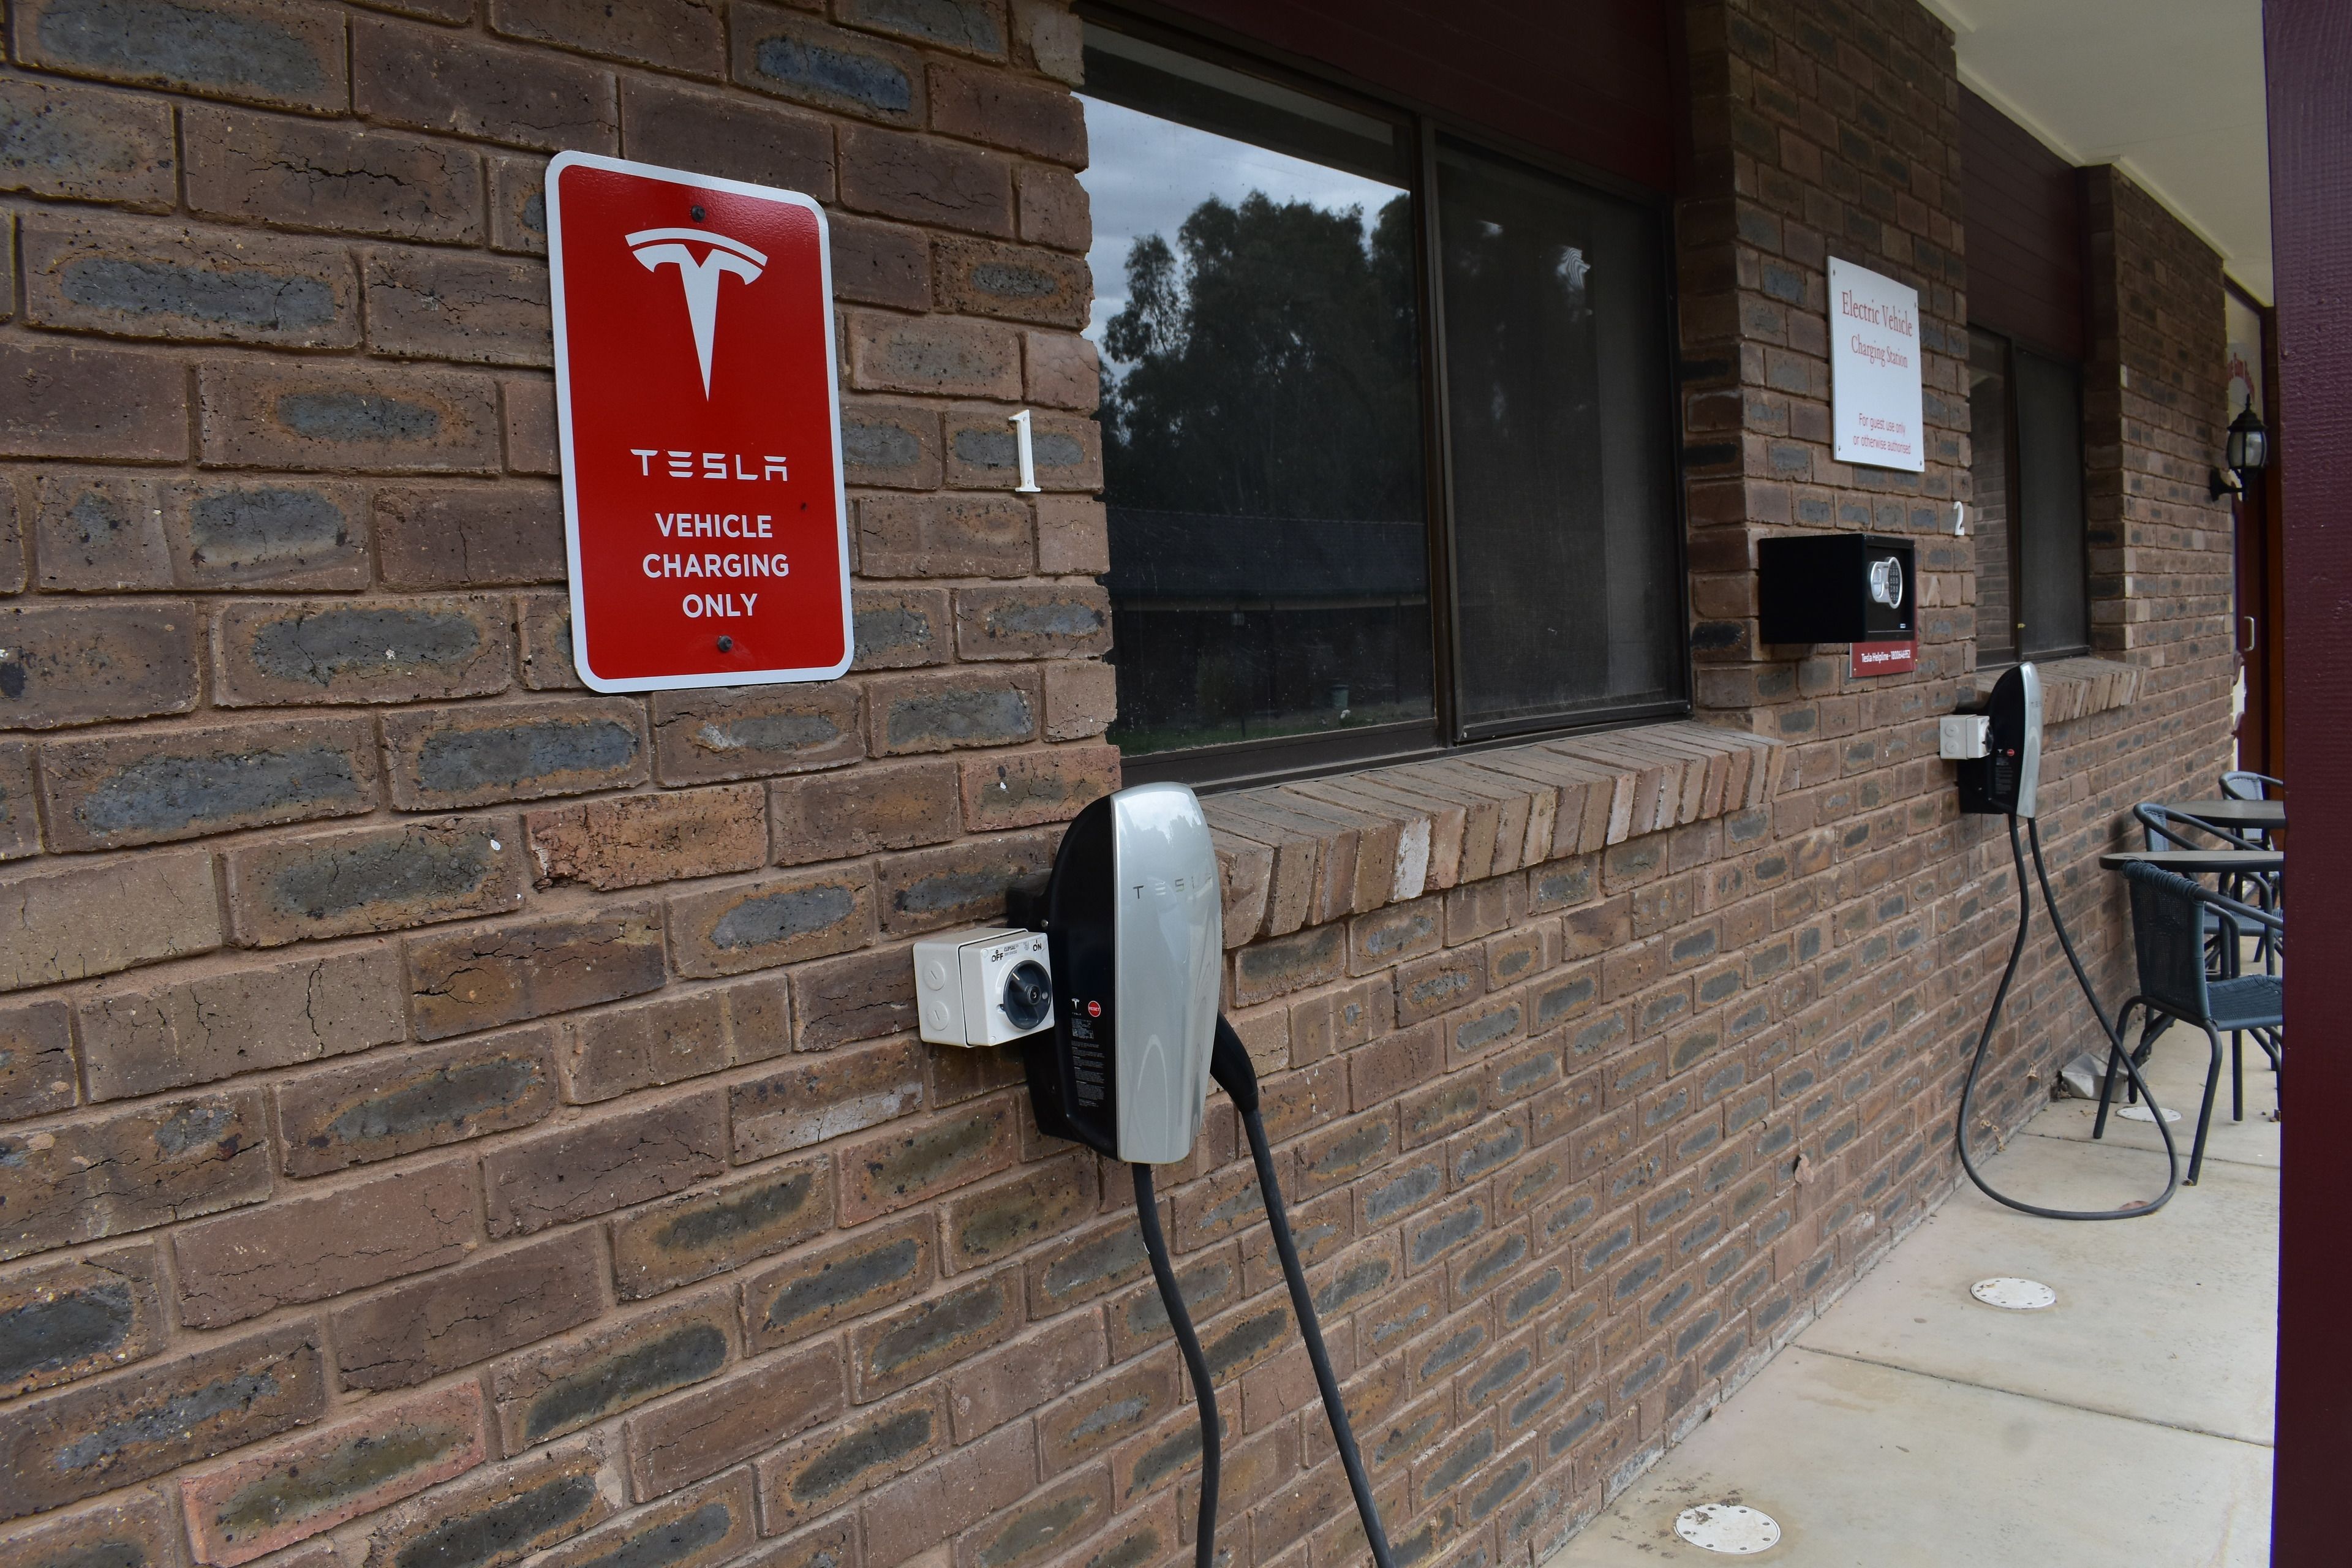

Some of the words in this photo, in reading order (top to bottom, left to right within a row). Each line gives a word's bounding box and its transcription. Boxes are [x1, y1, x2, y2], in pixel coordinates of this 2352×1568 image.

[1842, 289, 1880, 325] Electric
[1882, 304, 1912, 337] Vehicle
[1852, 334, 1885, 367] Charging
[1887, 345, 1908, 368] Station
[1859, 413, 1868, 426] For
[1870, 418, 1885, 431] guest
[1886, 421, 1894, 432] use
[1008, 409, 1041, 492] 1
[1853, 435, 1860, 445] or
[1861, 435, 1887, 450] otherwise
[630, 449, 788, 481] TESLA
[655, 513, 773, 538] VEHICLE
[1953, 501, 1965, 535] 2
[643, 554, 789, 578] CHARGING
[682, 593, 758, 618] ONLY
[1861, 653, 1872, 662] Tesla
[1872, 652, 1889, 663] Helpline
[991, 953, 1004, 962] OFF
[1033, 943, 1042, 952] ON
